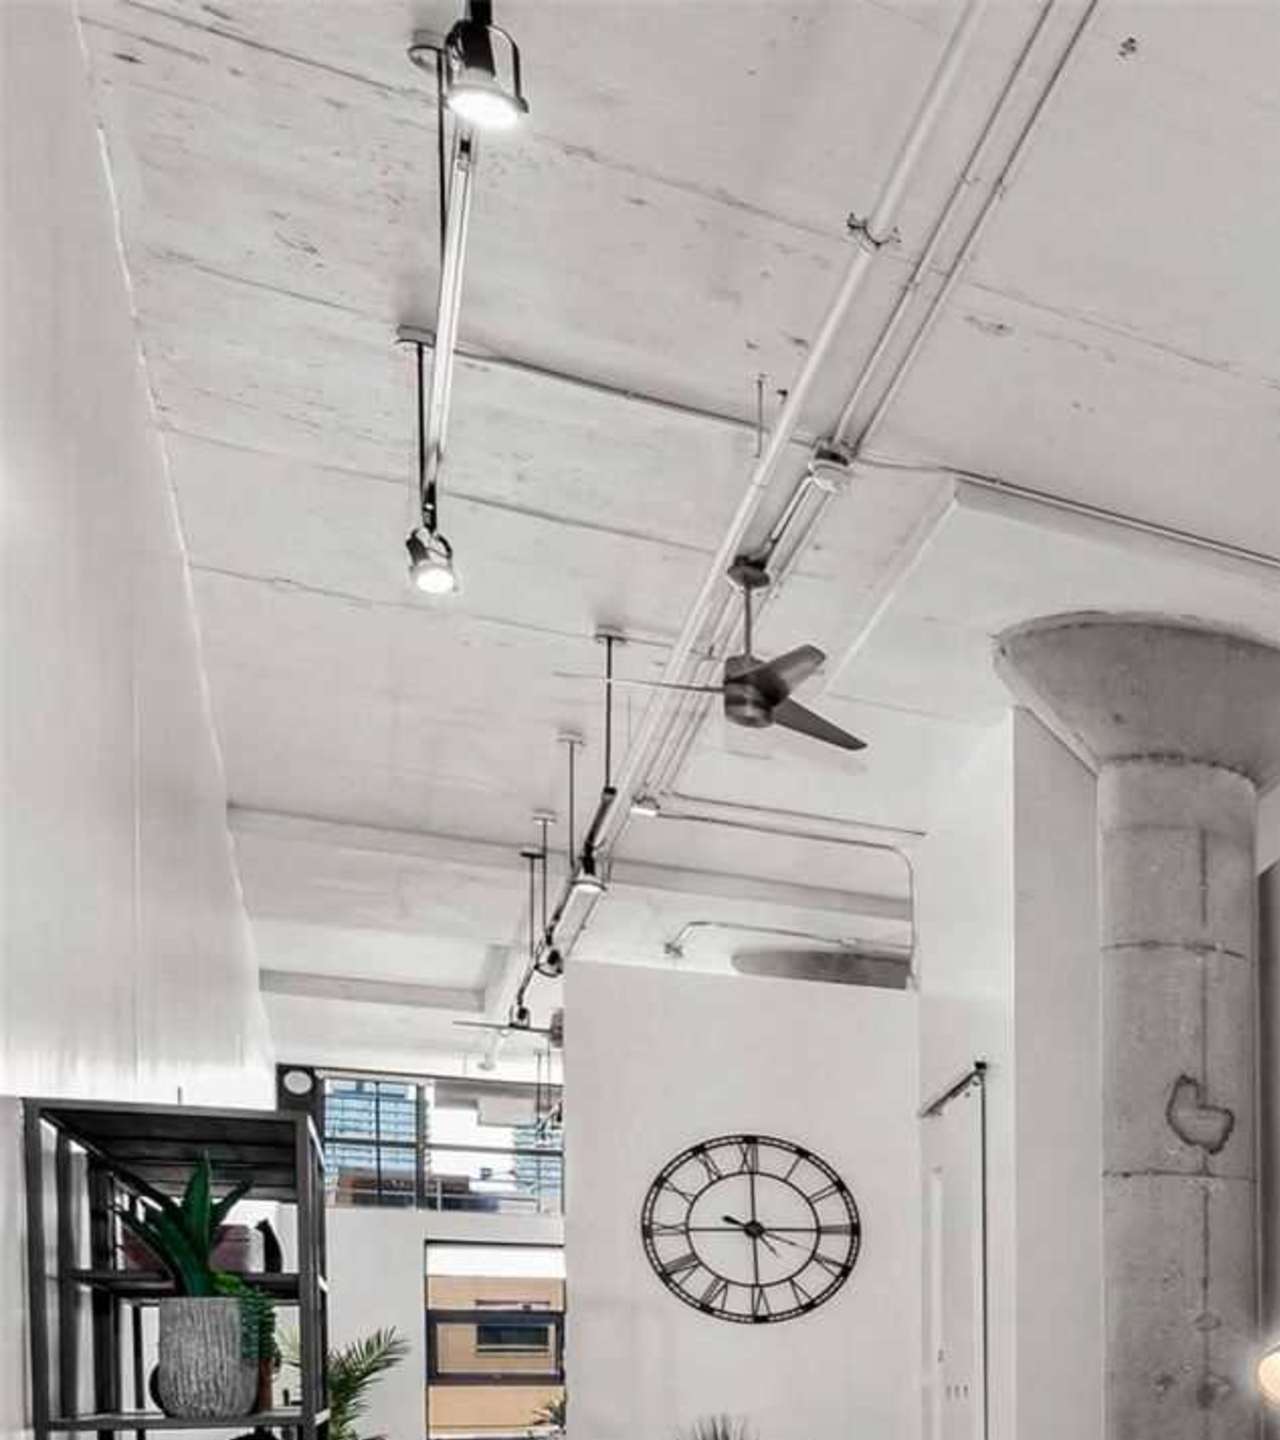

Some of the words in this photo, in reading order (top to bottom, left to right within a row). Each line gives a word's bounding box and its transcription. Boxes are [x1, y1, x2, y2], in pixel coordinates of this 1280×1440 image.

[663, 1177, 697, 1204] X
[808, 1183, 840, 1203] II
[752, 1286, 772, 1316] VI
[790, 1279, 813, 1306] V
